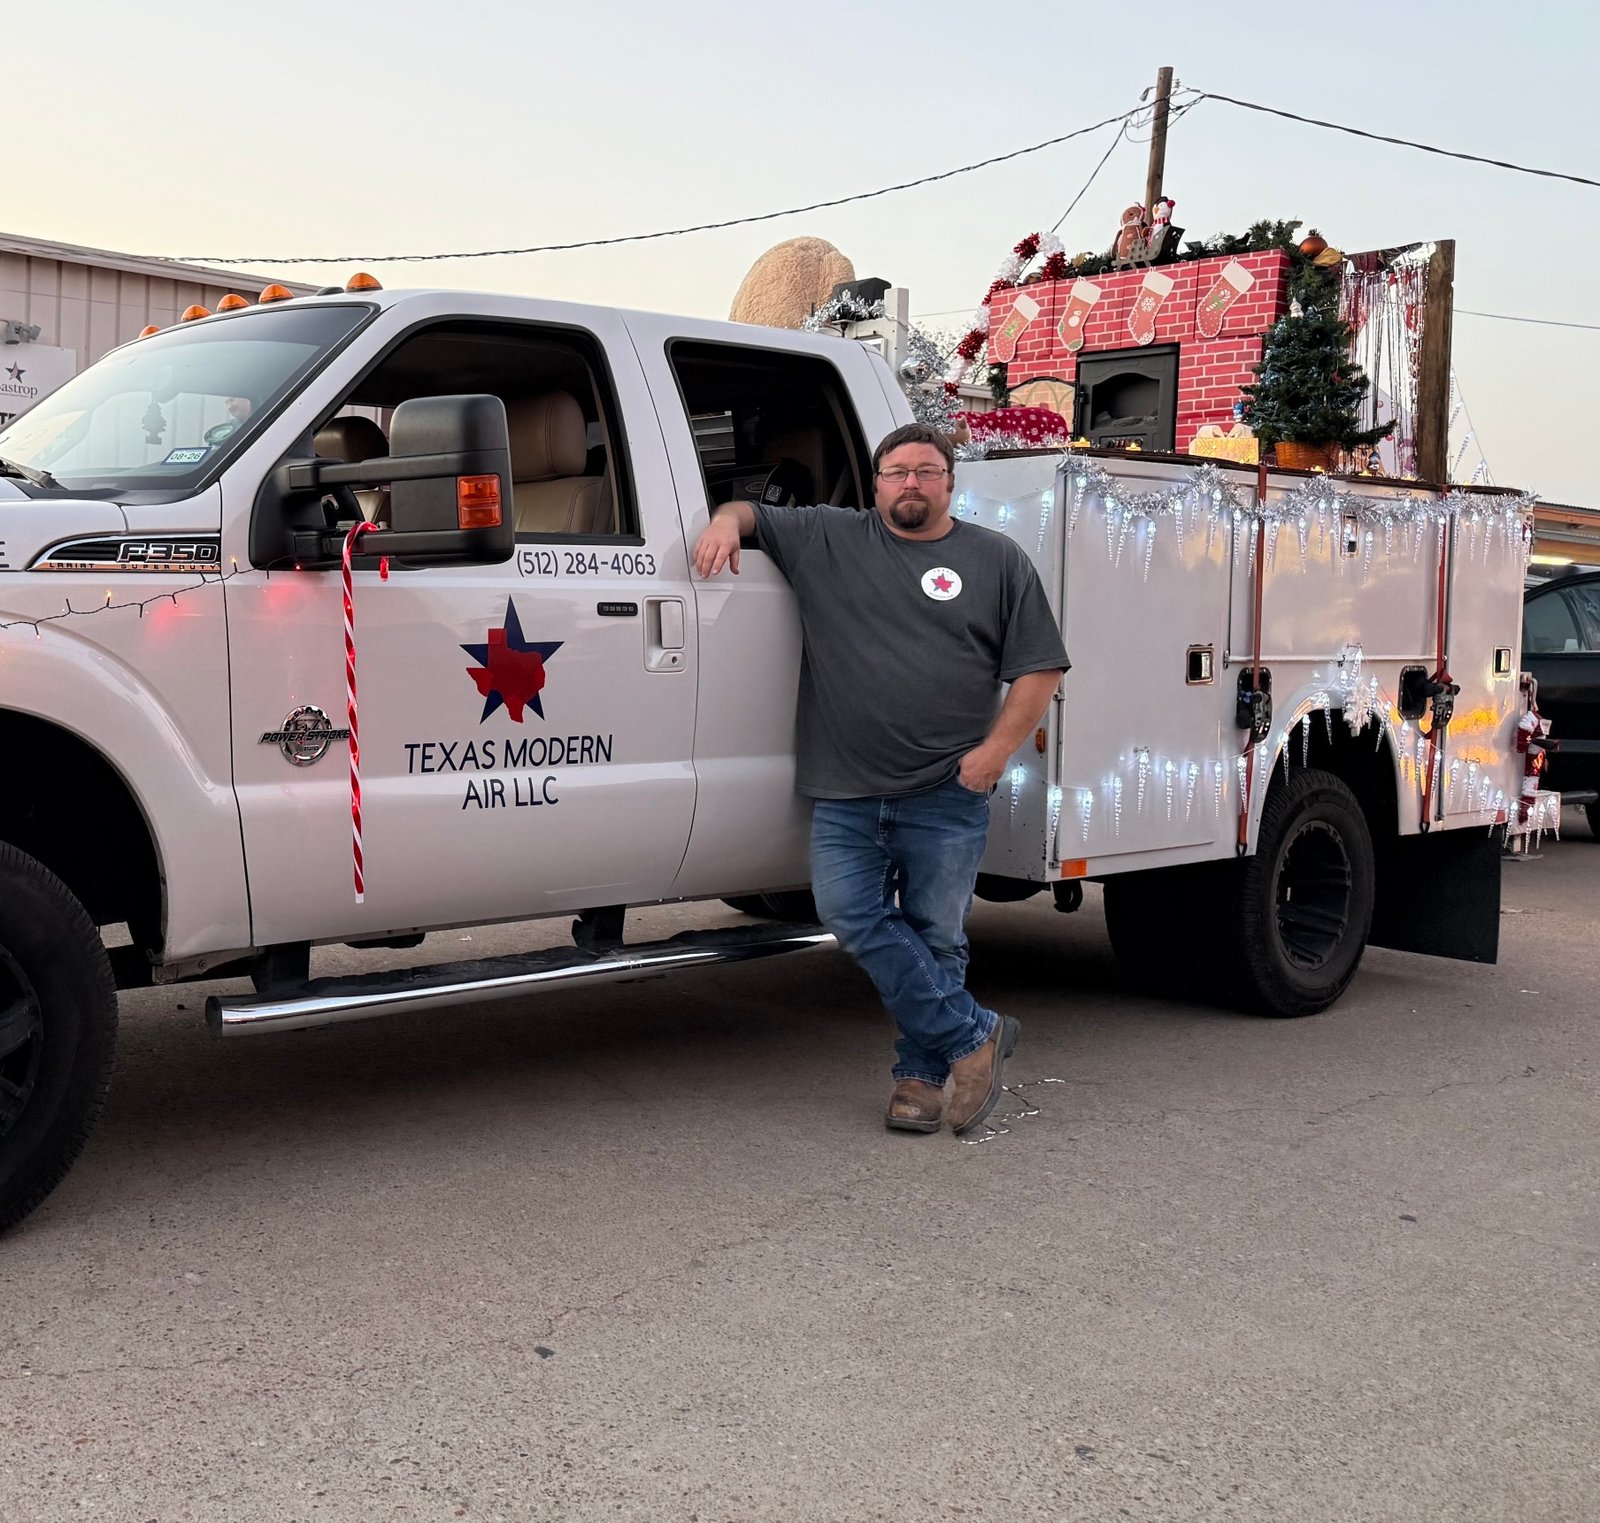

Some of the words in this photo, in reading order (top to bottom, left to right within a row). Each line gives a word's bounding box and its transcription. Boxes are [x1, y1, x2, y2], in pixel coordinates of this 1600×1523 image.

[0, 383, 38, 399] astrop
[116, 543, 218, 563] F-350
[517, 550, 558, 577] (512)
[565, 552, 656, 576] 284-4063
[404, 740, 496, 774] TEXAS
[503, 734, 613, 768] MODERN
[462, 779, 506, 810] AIR
[513, 776, 559, 807] LLC
